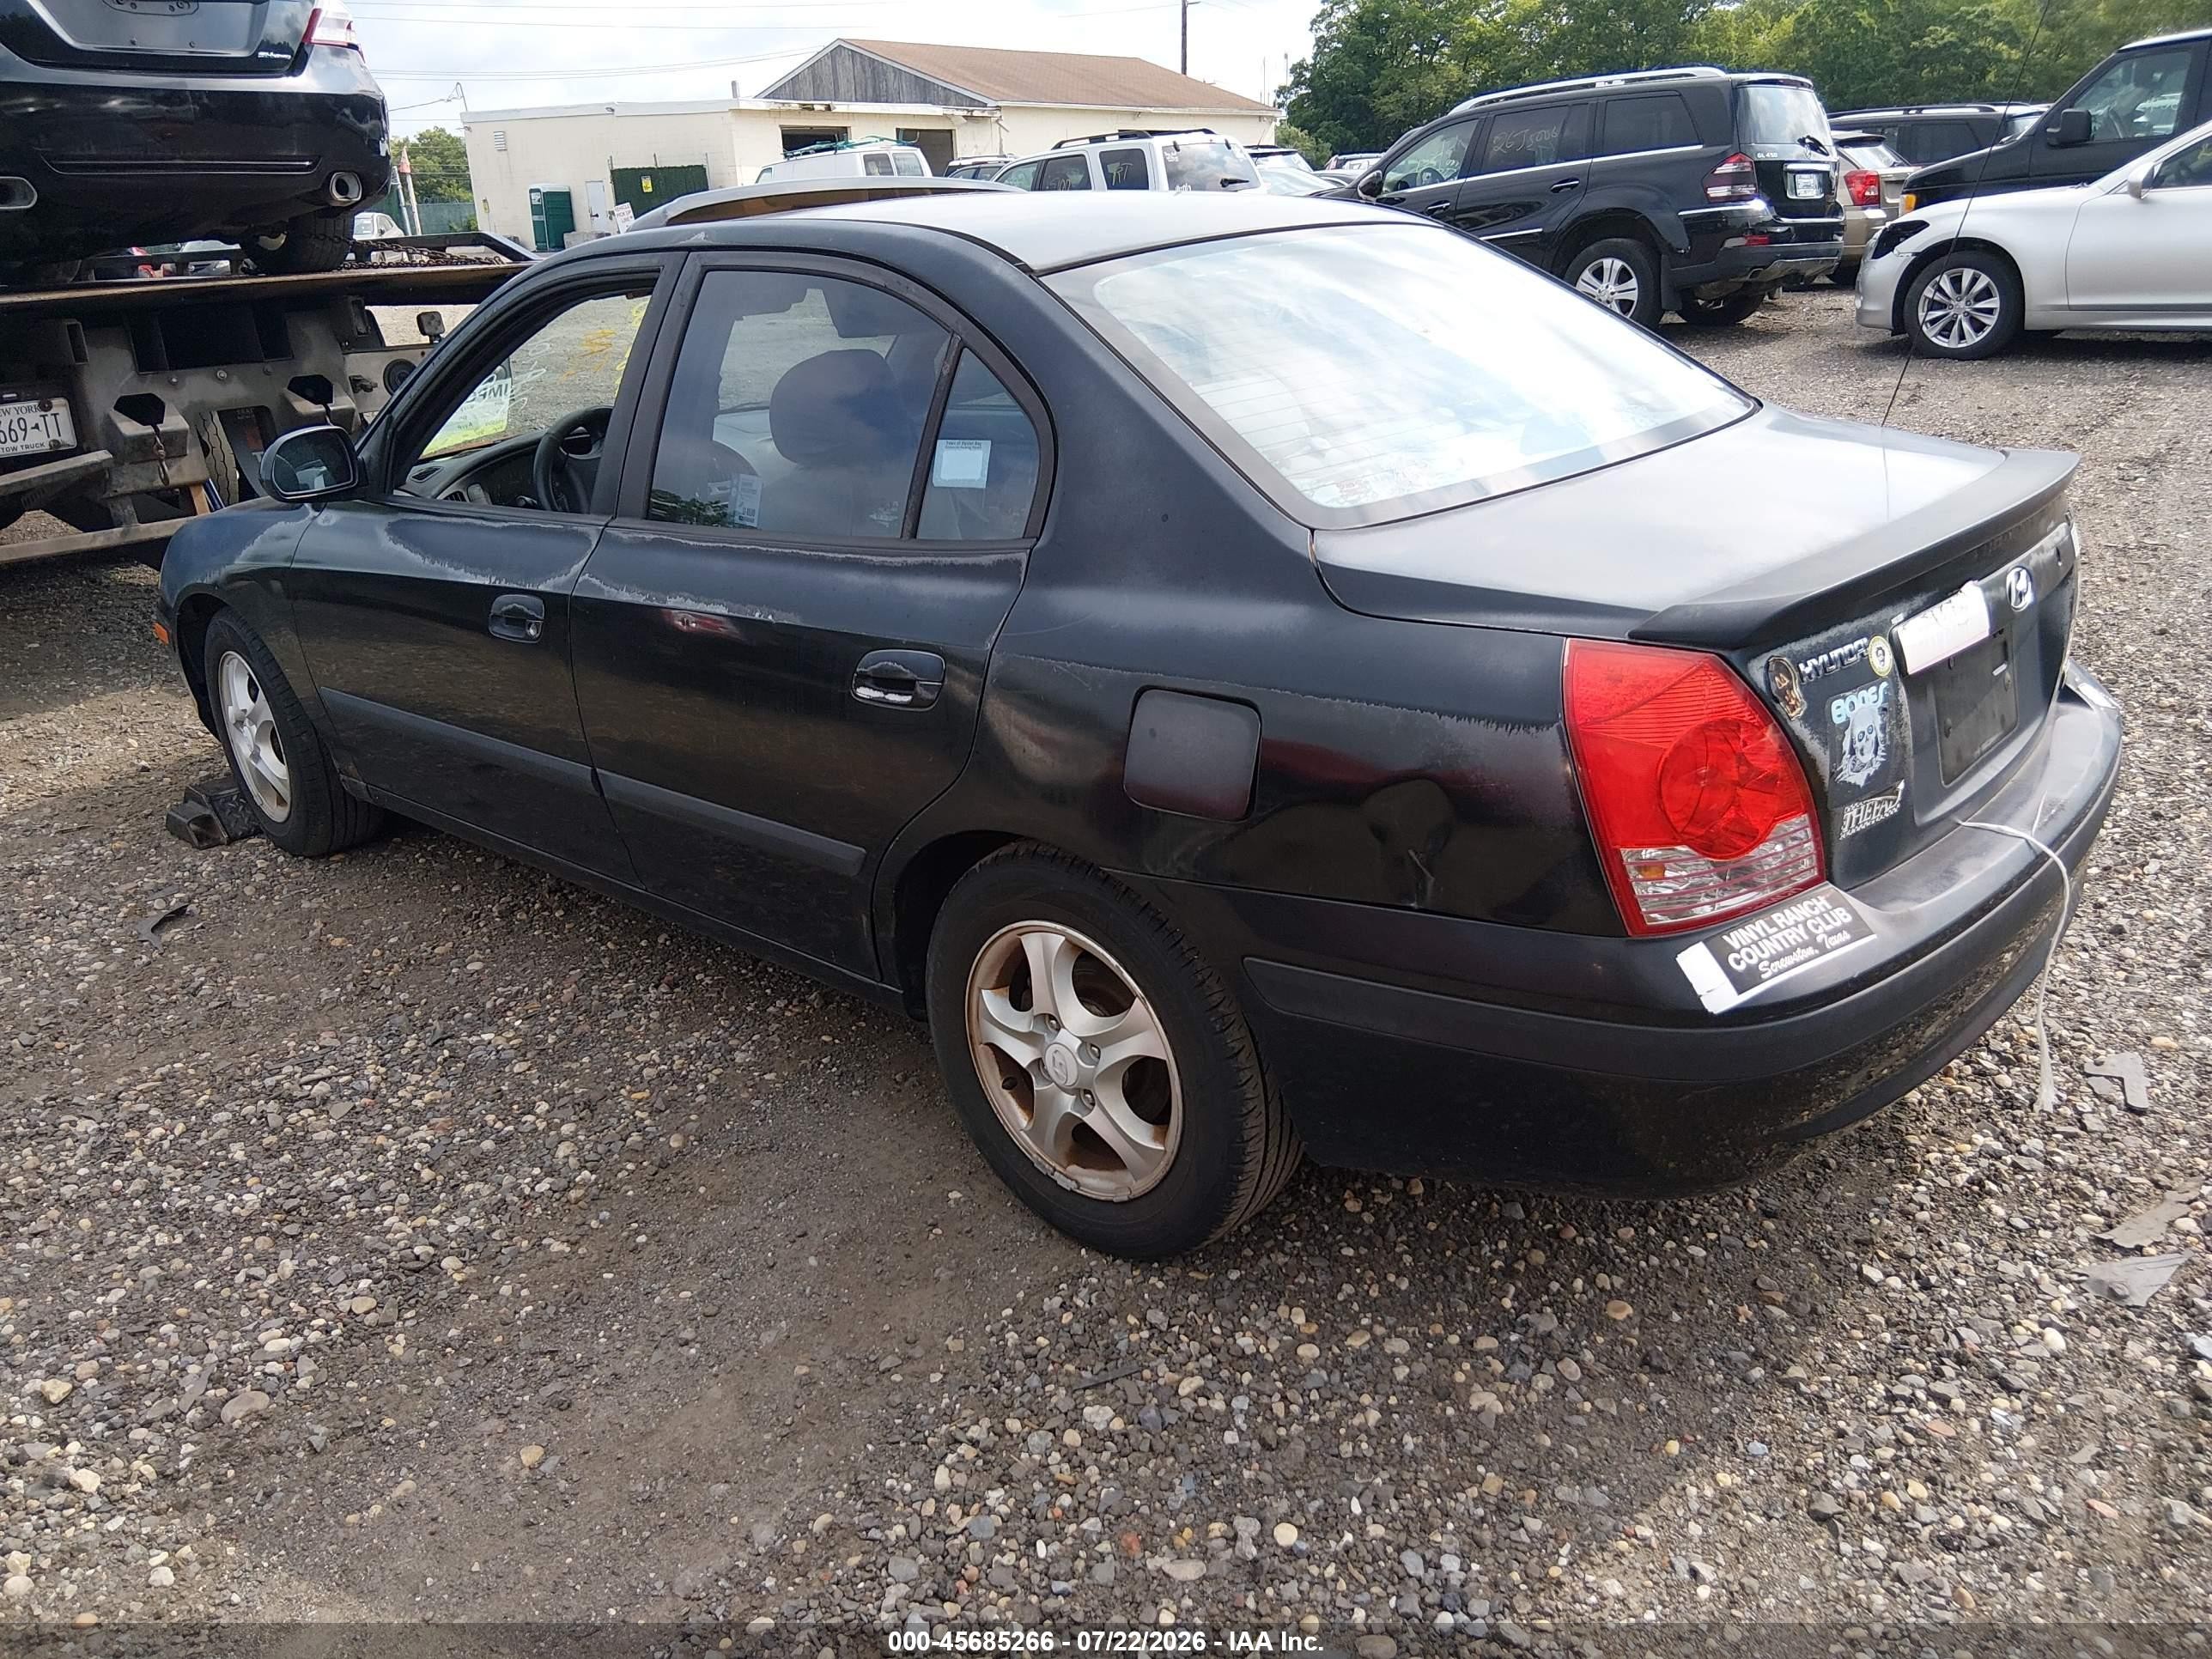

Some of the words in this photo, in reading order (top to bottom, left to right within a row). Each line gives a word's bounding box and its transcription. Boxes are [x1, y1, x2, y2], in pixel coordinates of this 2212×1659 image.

[14, 404, 41, 415] YORK
[1, 444, 18, 453] TOW
[21, 442, 46, 451] TRUCK
[1831, 681, 1890, 725] BONES
[1722, 918, 1778, 950] VINYL
[1771, 895, 1833, 929] RANCH
[1728, 922, 1810, 971] COUNTRY
[1806, 906, 1853, 937] CLUB
[1816, 930, 1851, 949] Texas
